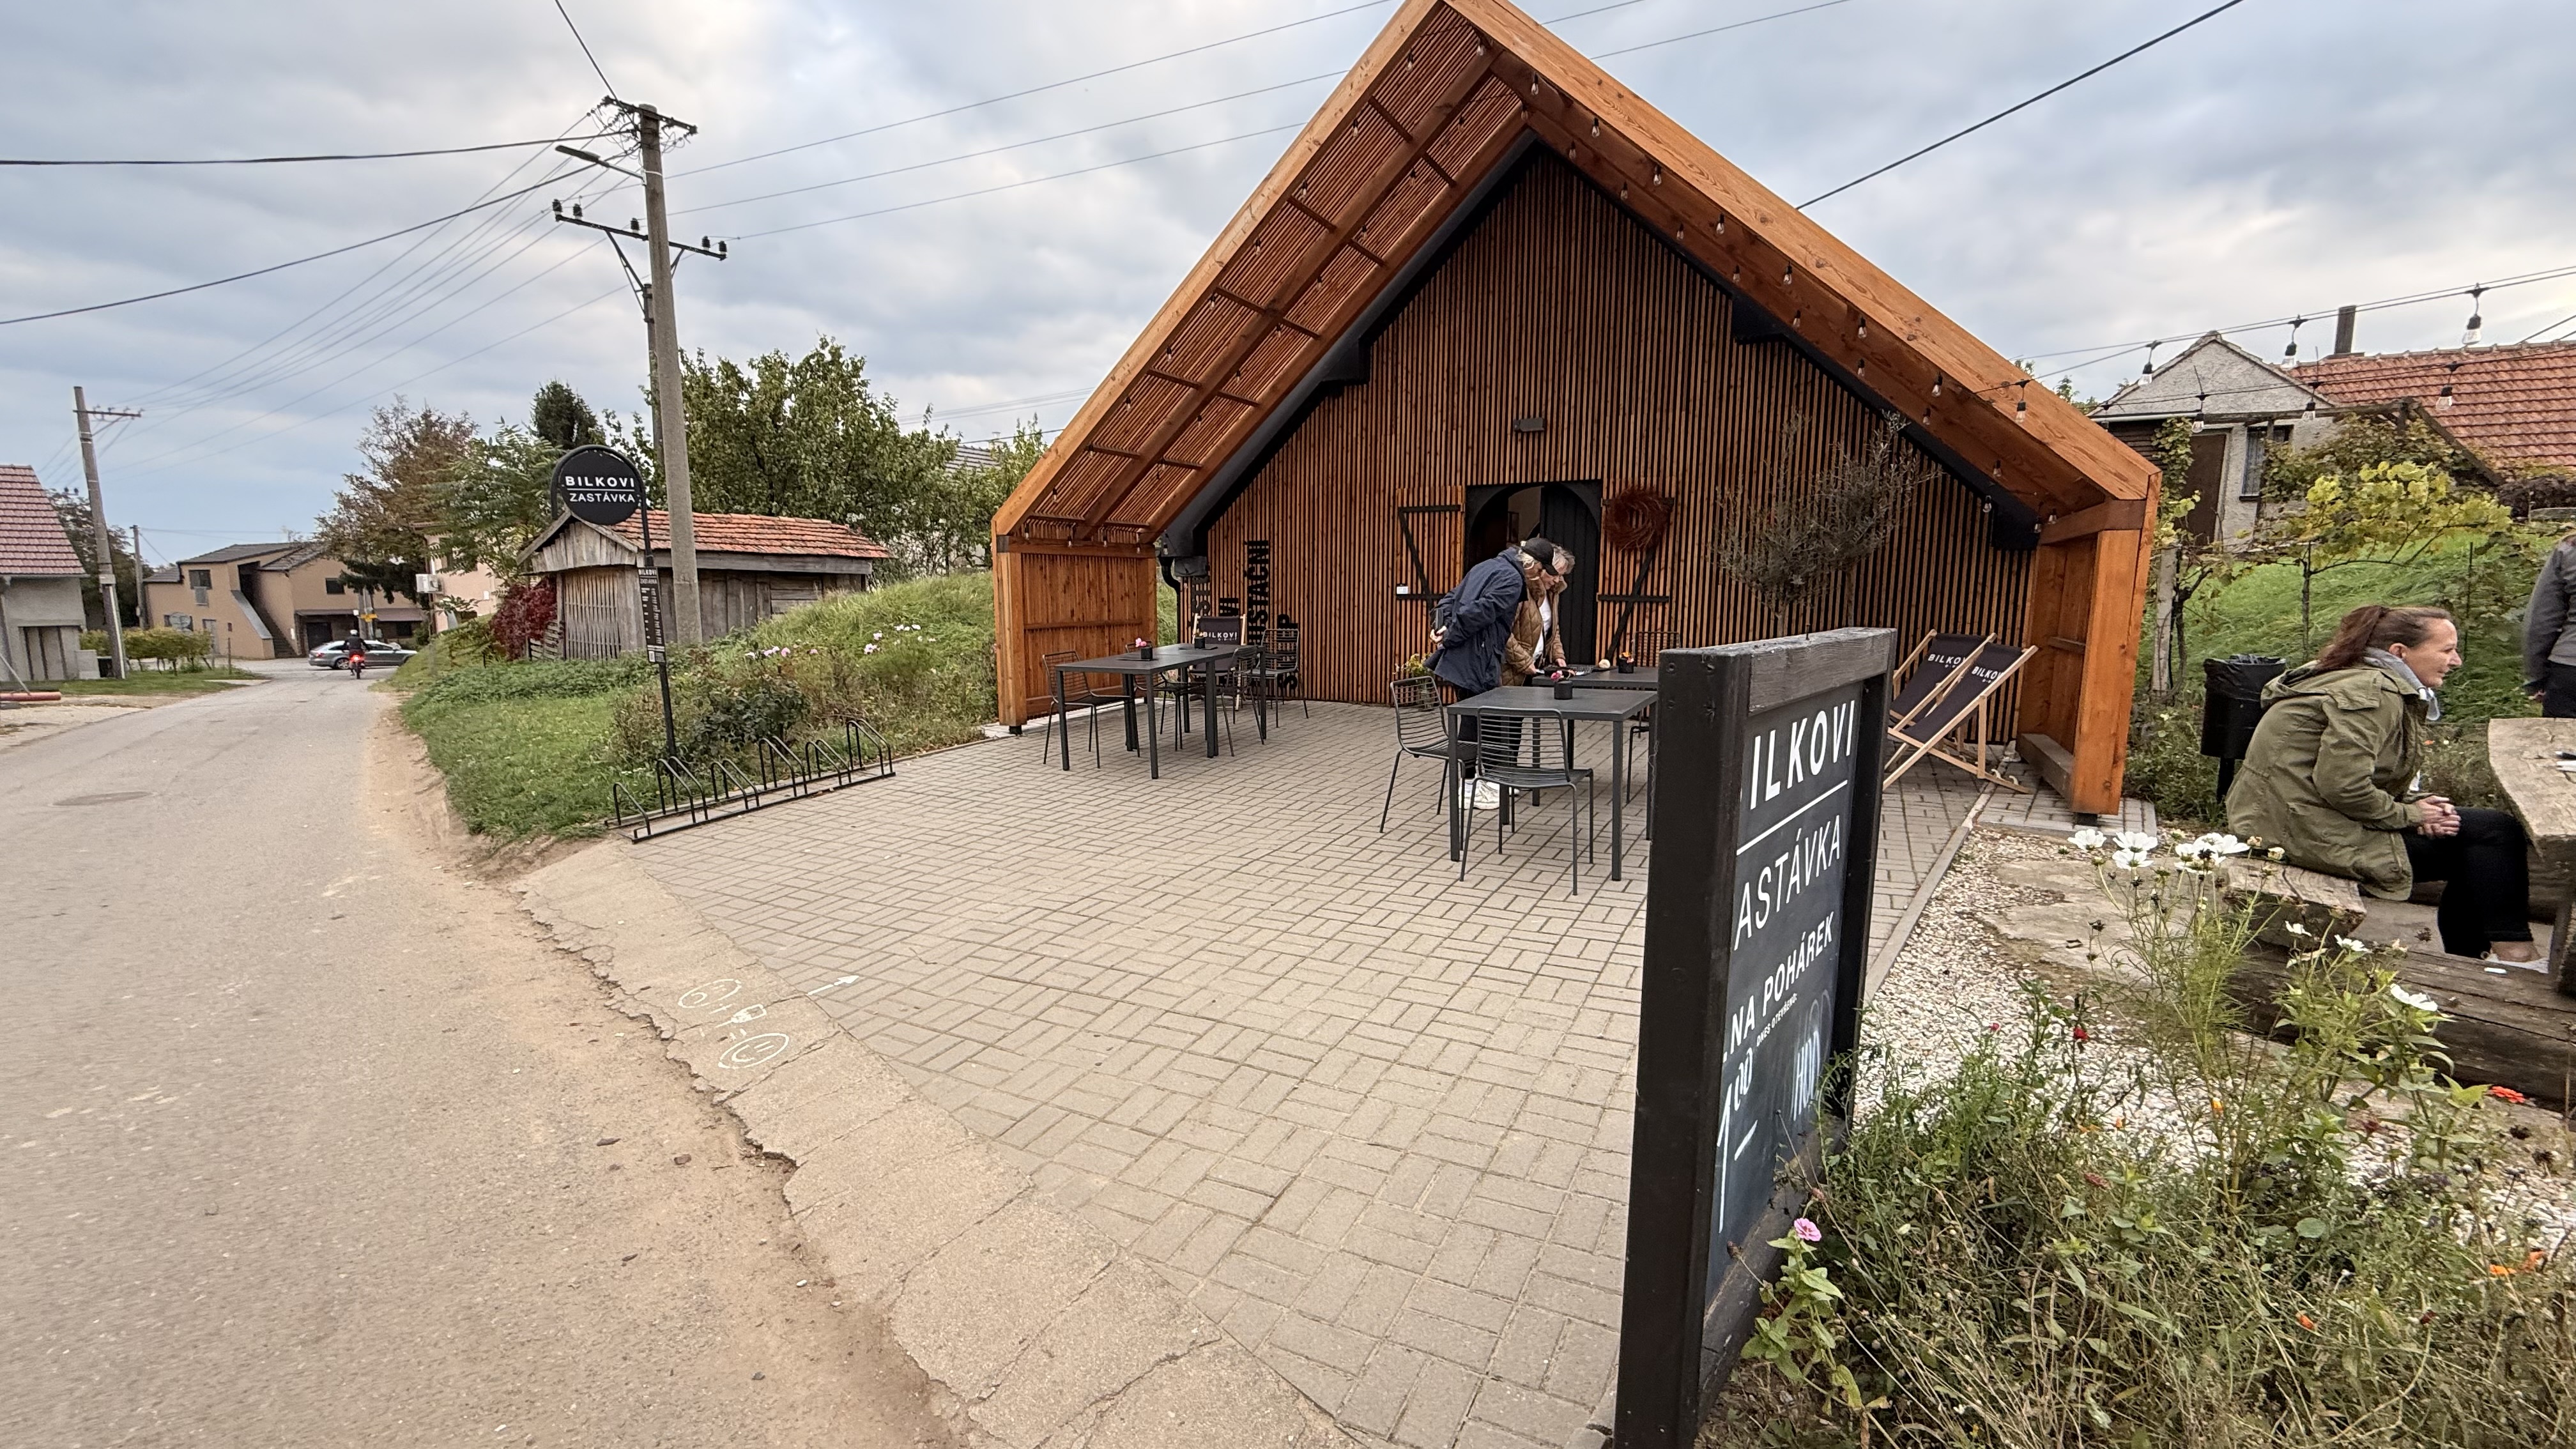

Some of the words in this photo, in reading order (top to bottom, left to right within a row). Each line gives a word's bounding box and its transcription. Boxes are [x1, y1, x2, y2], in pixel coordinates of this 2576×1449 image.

[565, 476, 634, 487] BILKOVI
[569, 491, 635, 502] ZASTÁVKA
[1928, 654, 1965, 664] BILKO
[1750, 700, 1855, 811] ILKOVI
[1734, 815, 1840, 951] ASTÁVKA
[1762, 911, 1834, 1017] POHÁREK
